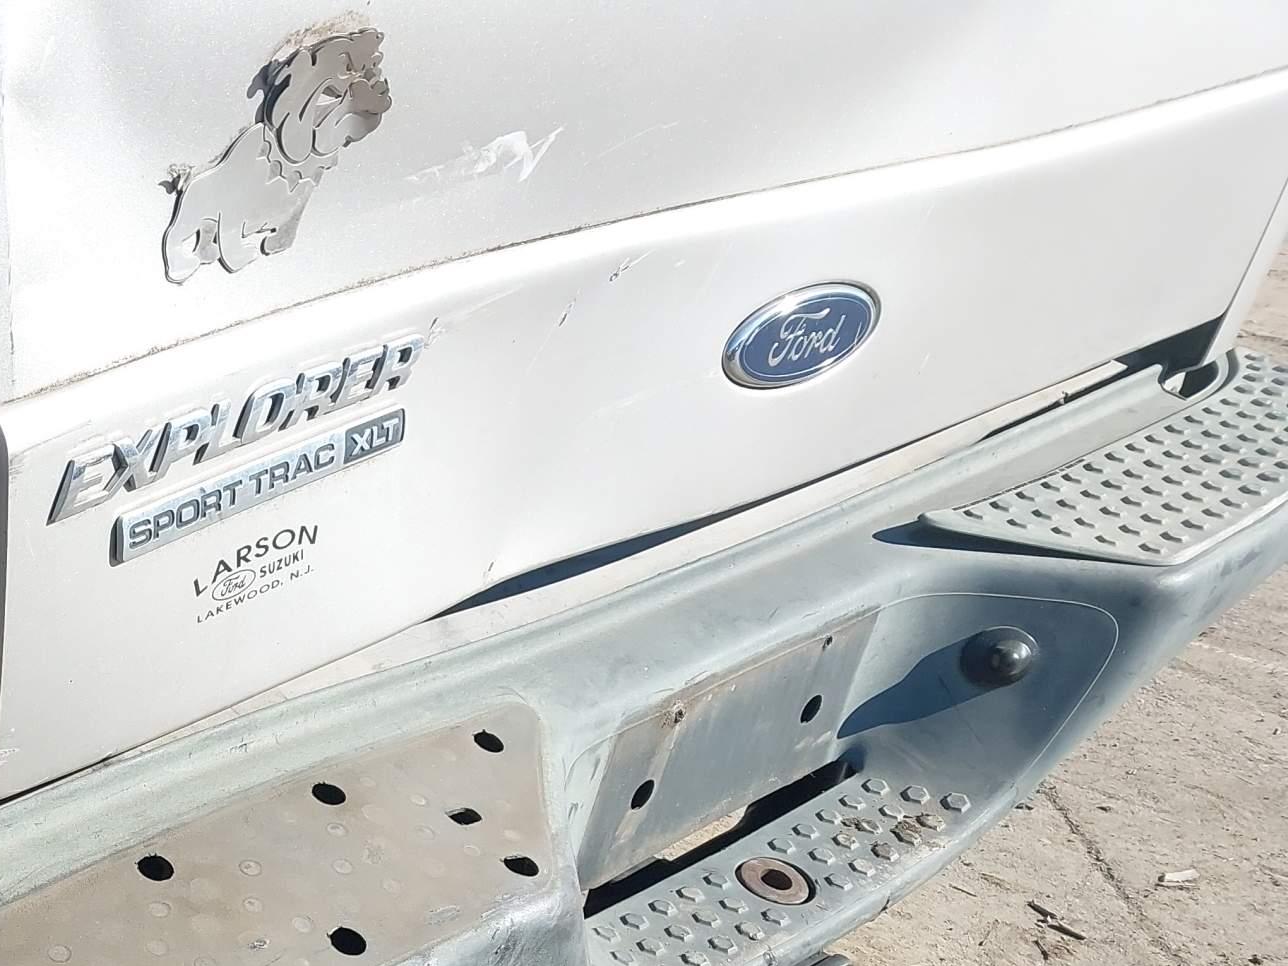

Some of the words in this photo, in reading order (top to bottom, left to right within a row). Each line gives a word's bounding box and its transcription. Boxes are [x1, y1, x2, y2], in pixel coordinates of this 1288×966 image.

[768, 308, 846, 367] Ford
[46, 334, 425, 526] EXPLORER
[128, 479, 243, 550] SPORT
[249, 442, 336, 496] TRAC
[350, 417, 402, 456] XLT
[193, 525, 318, 597] LARSON
[197, 579, 284, 624] LAKEWOOD,
[289, 564, 314, 581] N.J.
[220, 575, 248, 597] Ford
[259, 549, 304, 578] SUZUKI
